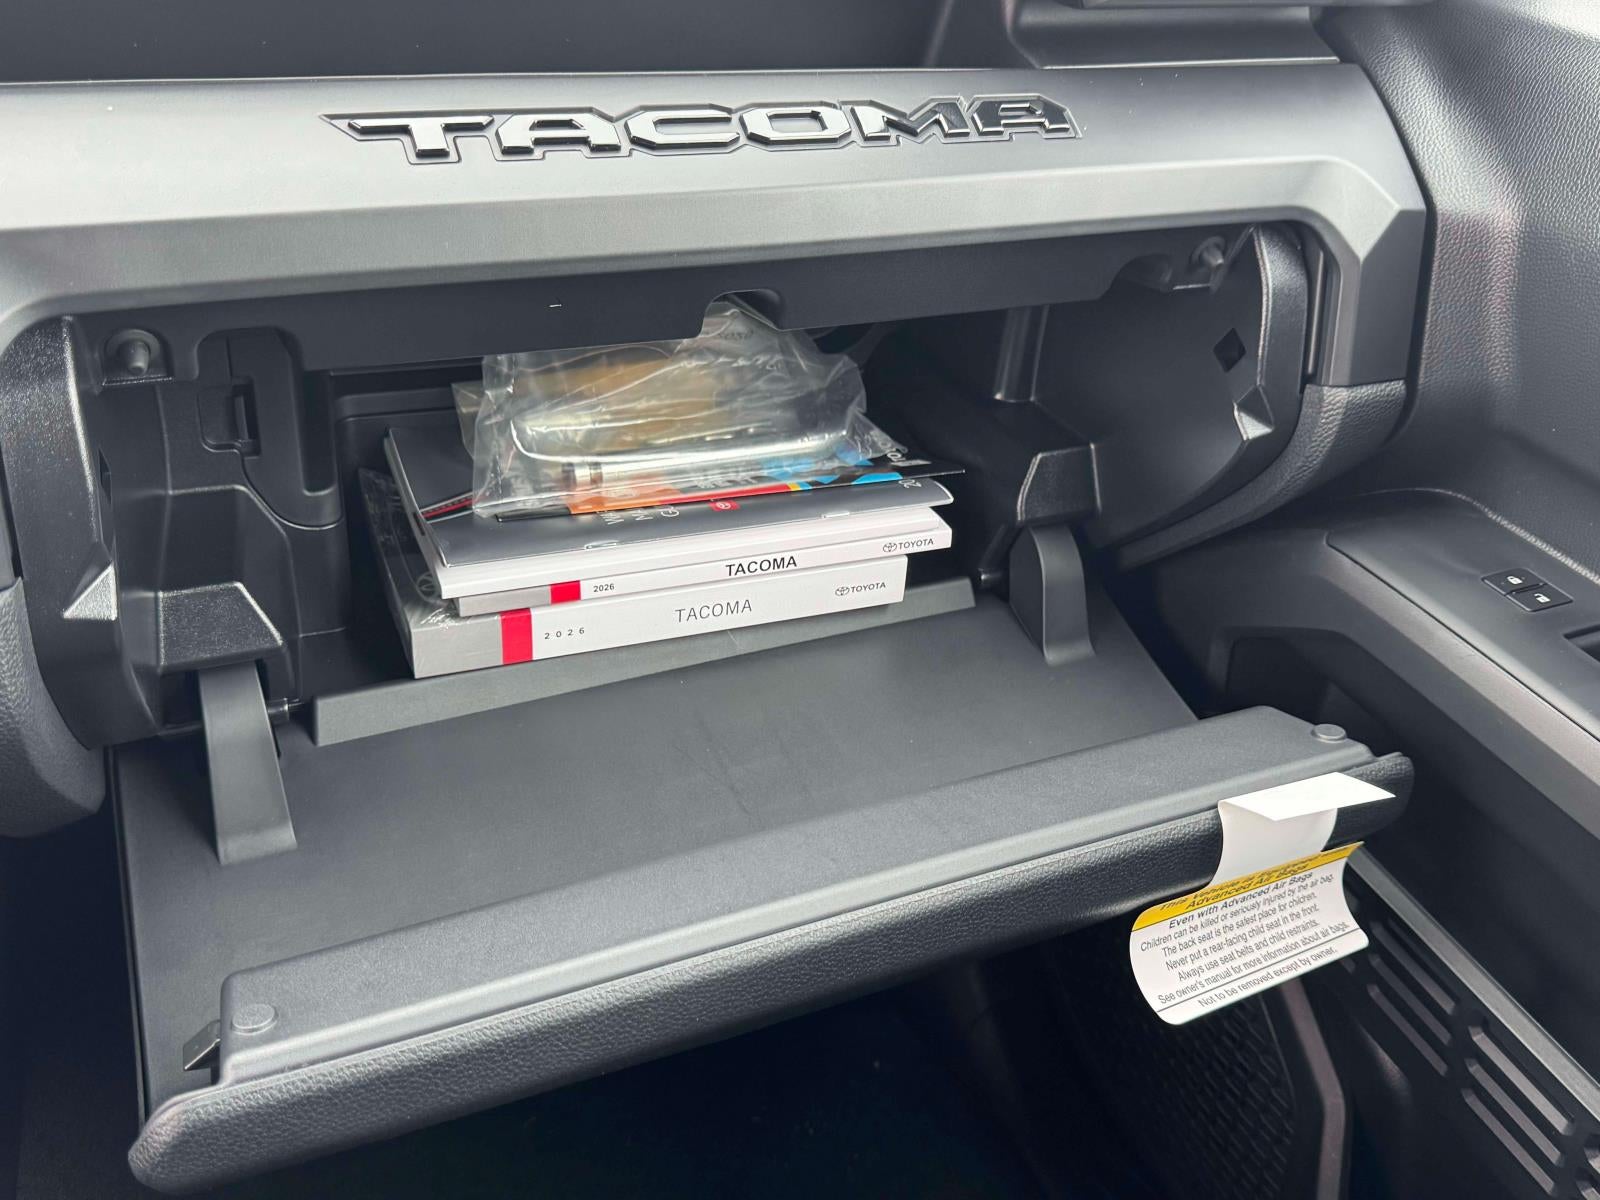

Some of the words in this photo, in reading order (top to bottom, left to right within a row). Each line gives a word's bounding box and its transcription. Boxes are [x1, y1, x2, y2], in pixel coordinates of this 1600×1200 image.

[346, 97, 1073, 159] TACOMA
[593, 583, 615, 593] 2026
[725, 555, 797, 577] TACOMA
[898, 538, 934, 551] TOYOTA
[544, 627, 585, 640] 2026
[675, 599, 752, 623] TACOMA
[851, 581, 887, 593] TOYOTA
[1141, 933, 1172, 952] Children
[1174, 929, 1188, 940] can
[1190, 924, 1197, 934] be
[1201, 916, 1219, 930] killed
[1230, 900, 1262, 920] seriously
[1264, 891, 1287, 907] injured
[1288, 888, 1296, 898] by
[1298, 883, 1308, 892] the
[1310, 879, 1319, 888] air
[1162, 944, 1178, 957] The
[1178, 937, 1197, 952] back
[1197, 931, 1215, 943] seat
[1222, 923, 1235, 934] the
[1235, 914, 1258, 929] safest
[1257, 907, 1279, 922] place
[1278, 902, 1289, 913] for
[1170, 913, 1193, 929] Even
[1199, 905, 1218, 919] with
[1222, 886, 1270, 911] Advanced
[1273, 881, 1286, 892] Air
[1290, 871, 1312, 887] Bags
[1158, 992, 1176, 1004] See
[1175, 980, 1205, 997] owner's
[1204, 969, 1233, 985] manual
[1231, 964, 1243, 974] for
[1243, 958, 1263, 969] more
[1261, 941, 1303, 962] information
[1300, 932, 1322, 946] about
[1320, 928, 1331, 938] air
[1166, 955, 1190, 971] Never
[1189, 950, 1204, 964] put
[1208, 932, 1249, 955] rear-facing
[1247, 925, 1265, 938] child
[1265, 919, 1282, 931] seat
[1290, 911, 1302, 921] the
[1178, 965, 1206, 982] Always
[1205, 960, 1220, 971] use
[1219, 953, 1236, 965] seat
[1235, 944, 1255, 958] belts
[1254, 939, 1270, 950] and
[1268, 931, 1287, 945] child
[1198, 996, 1216, 1007] Not
[1215, 993, 1226, 1001] to
[1225, 987, 1239, 997] be
[1237, 973, 1274, 991] removed
[1273, 962, 1301, 977] except
[1299, 958, 1312, 967] by
[1311, 947, 1339, 961] owner.
